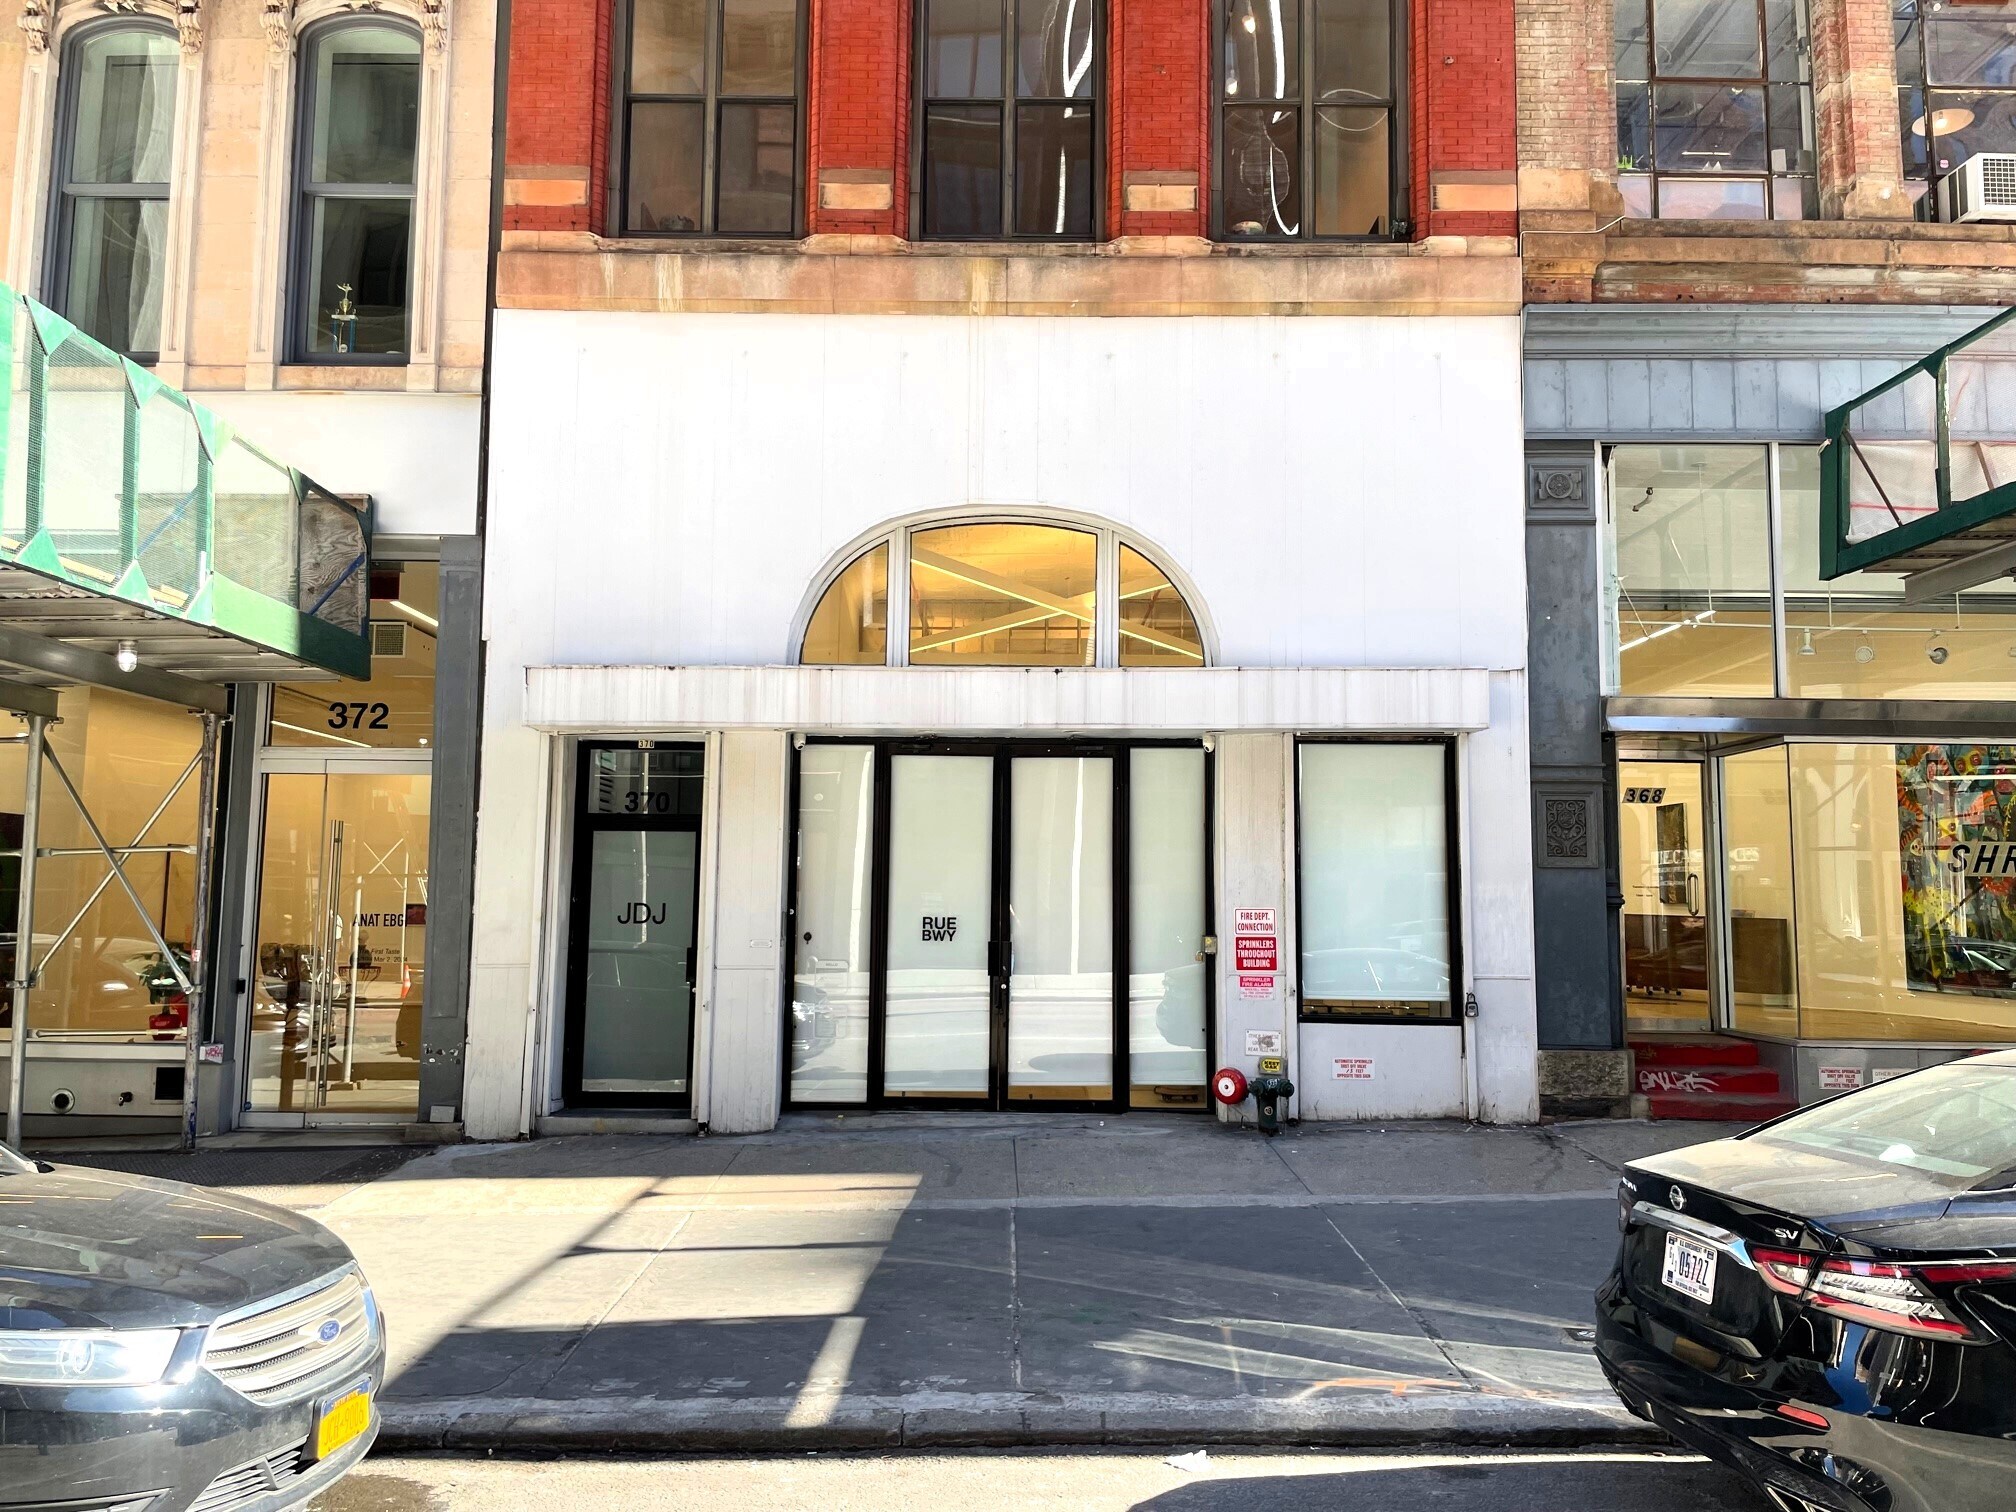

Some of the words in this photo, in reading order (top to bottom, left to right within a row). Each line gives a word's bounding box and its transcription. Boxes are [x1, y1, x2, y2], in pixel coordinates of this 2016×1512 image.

[328, 702, 389, 729] 372
[639, 740, 654, 748] 370
[624, 791, 670, 813] 370
[1626, 788, 1663, 803] 368
[1947, 844, 2016, 873] SHR
[353, 913, 380, 927] ANAT
[617, 902, 667, 925] JDJ
[1240, 912, 1253, 921] FIRE
[1254, 912, 1271, 921] DEPT.
[922, 916, 957, 930] RUE
[1237, 922, 1273, 932] CONNECTION
[921, 929, 956, 942] BWY
[1238, 939, 1274, 949] SPRINKLERS
[385, 947, 400, 955] Taste
[1236, 949, 1276, 959] THROUGHOUT
[1242, 958, 1271, 968] BUILDING
[1774, 1227, 1799, 1240] SV
[323, 1323, 337, 1339] Ford
